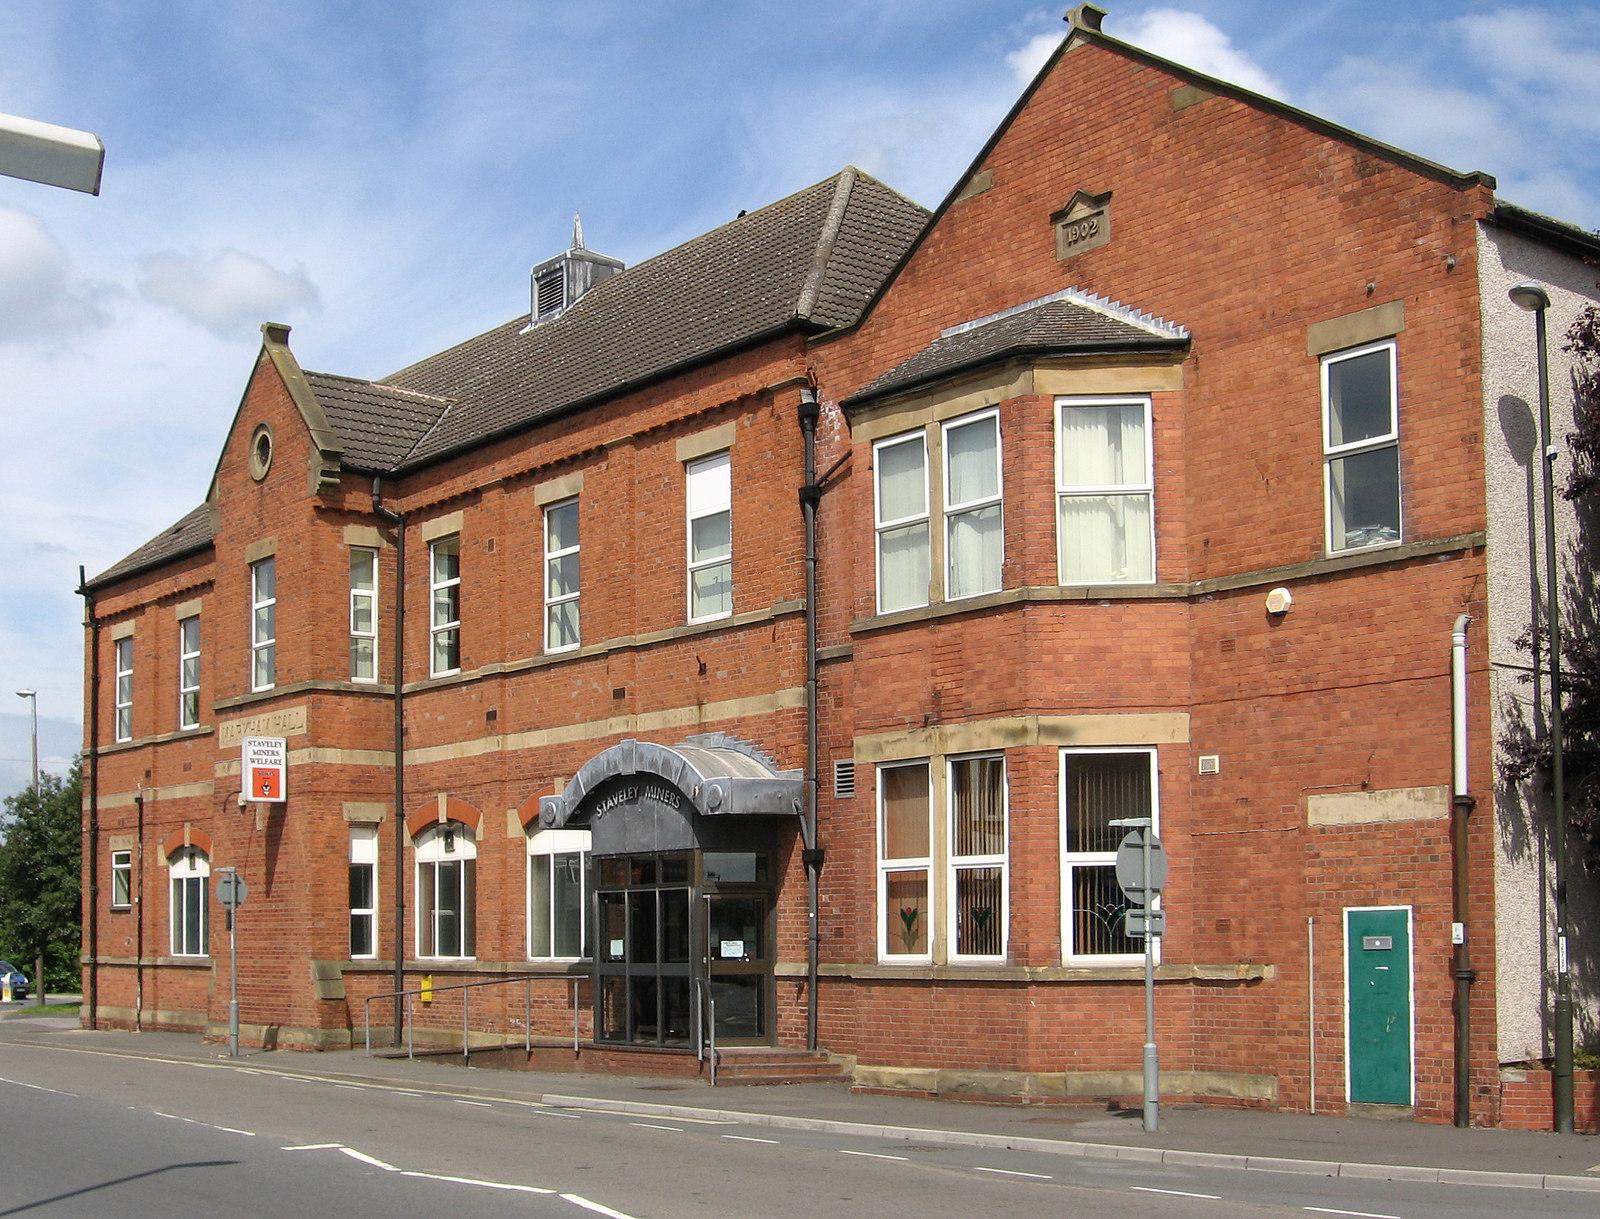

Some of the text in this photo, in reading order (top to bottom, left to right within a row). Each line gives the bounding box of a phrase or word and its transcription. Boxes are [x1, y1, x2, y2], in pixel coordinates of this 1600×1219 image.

[1067, 220, 1098, 242] 1902
[273, 712, 303, 734] HALL
[247, 740, 283, 748] STAVELEY
[252, 749, 280, 757] MINERS
[250, 757, 282, 766] WELFARE
[596, 785, 681, 818] STAVELEY MINERS
